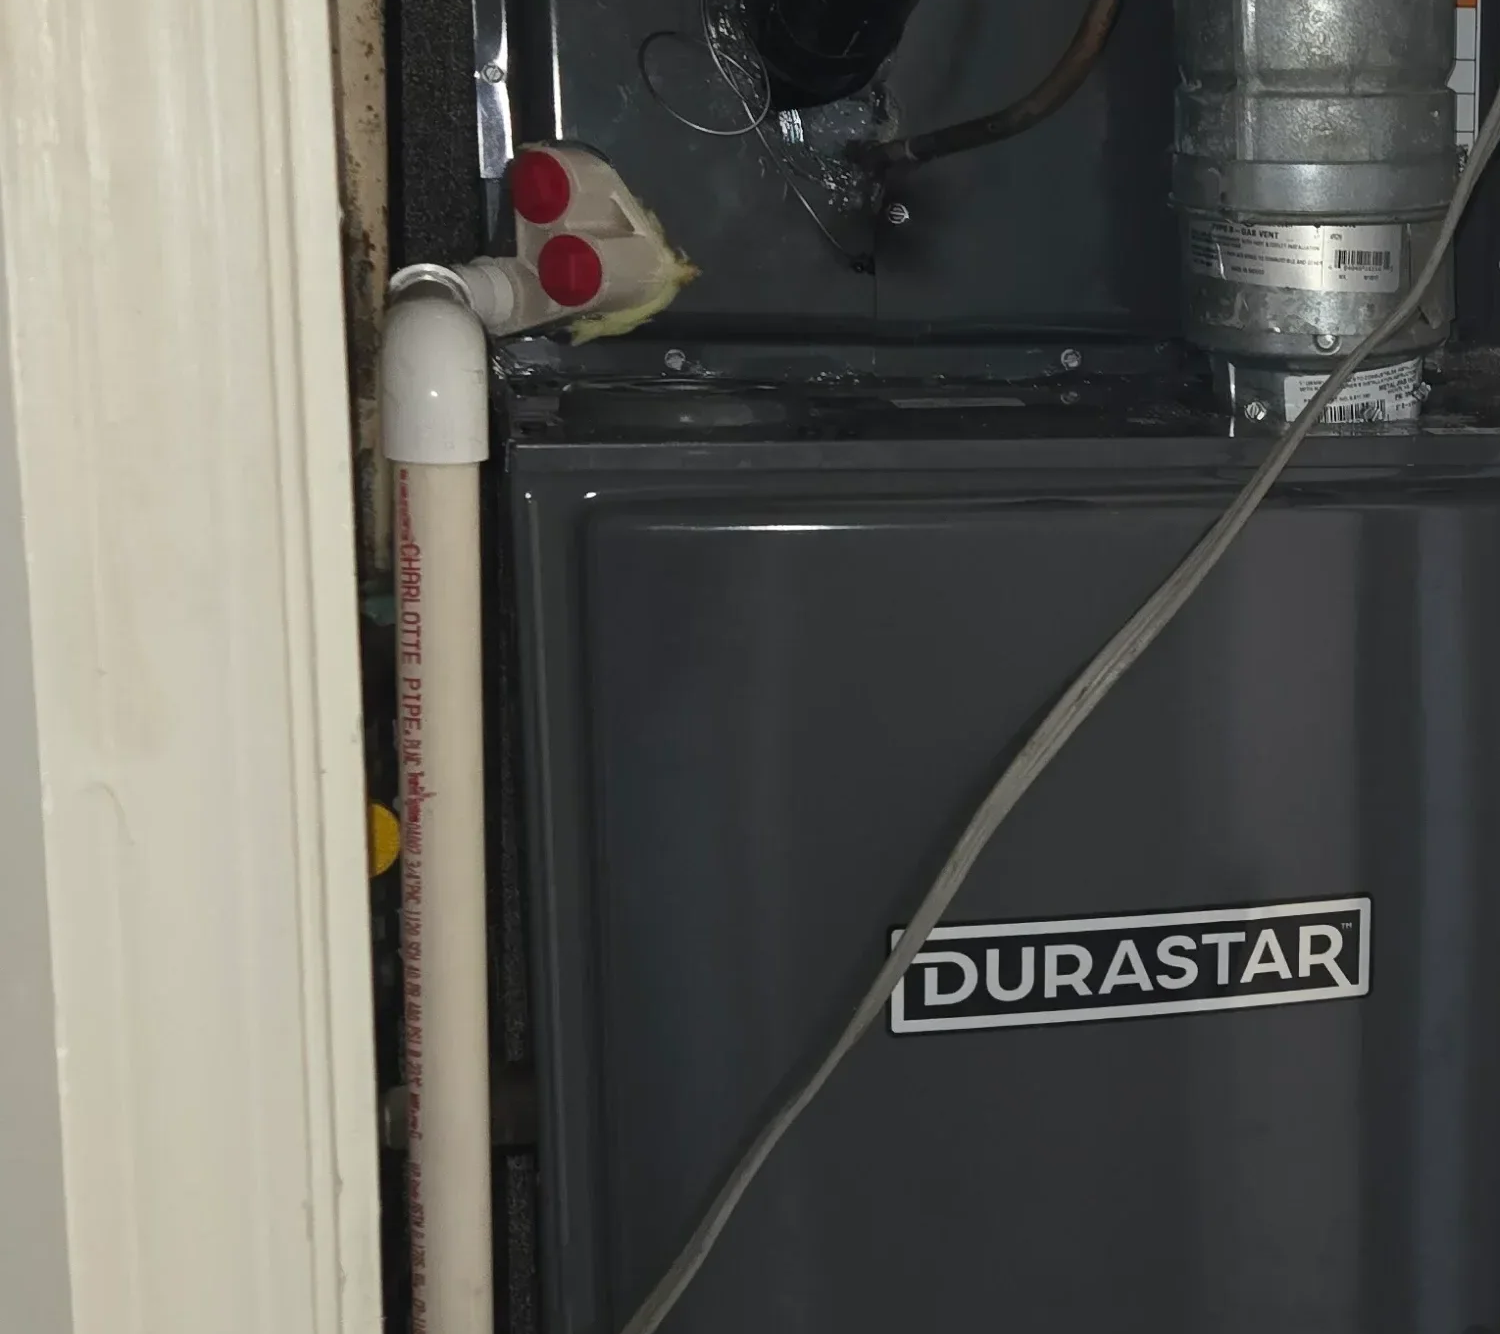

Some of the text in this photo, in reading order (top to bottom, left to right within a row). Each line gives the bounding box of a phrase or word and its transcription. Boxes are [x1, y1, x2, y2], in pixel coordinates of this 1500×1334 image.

[1260, 230, 1279, 240] VENT
[401, 543, 422, 666] CHARLOTTE
[921, 924, 1354, 1007] DURASTAR
